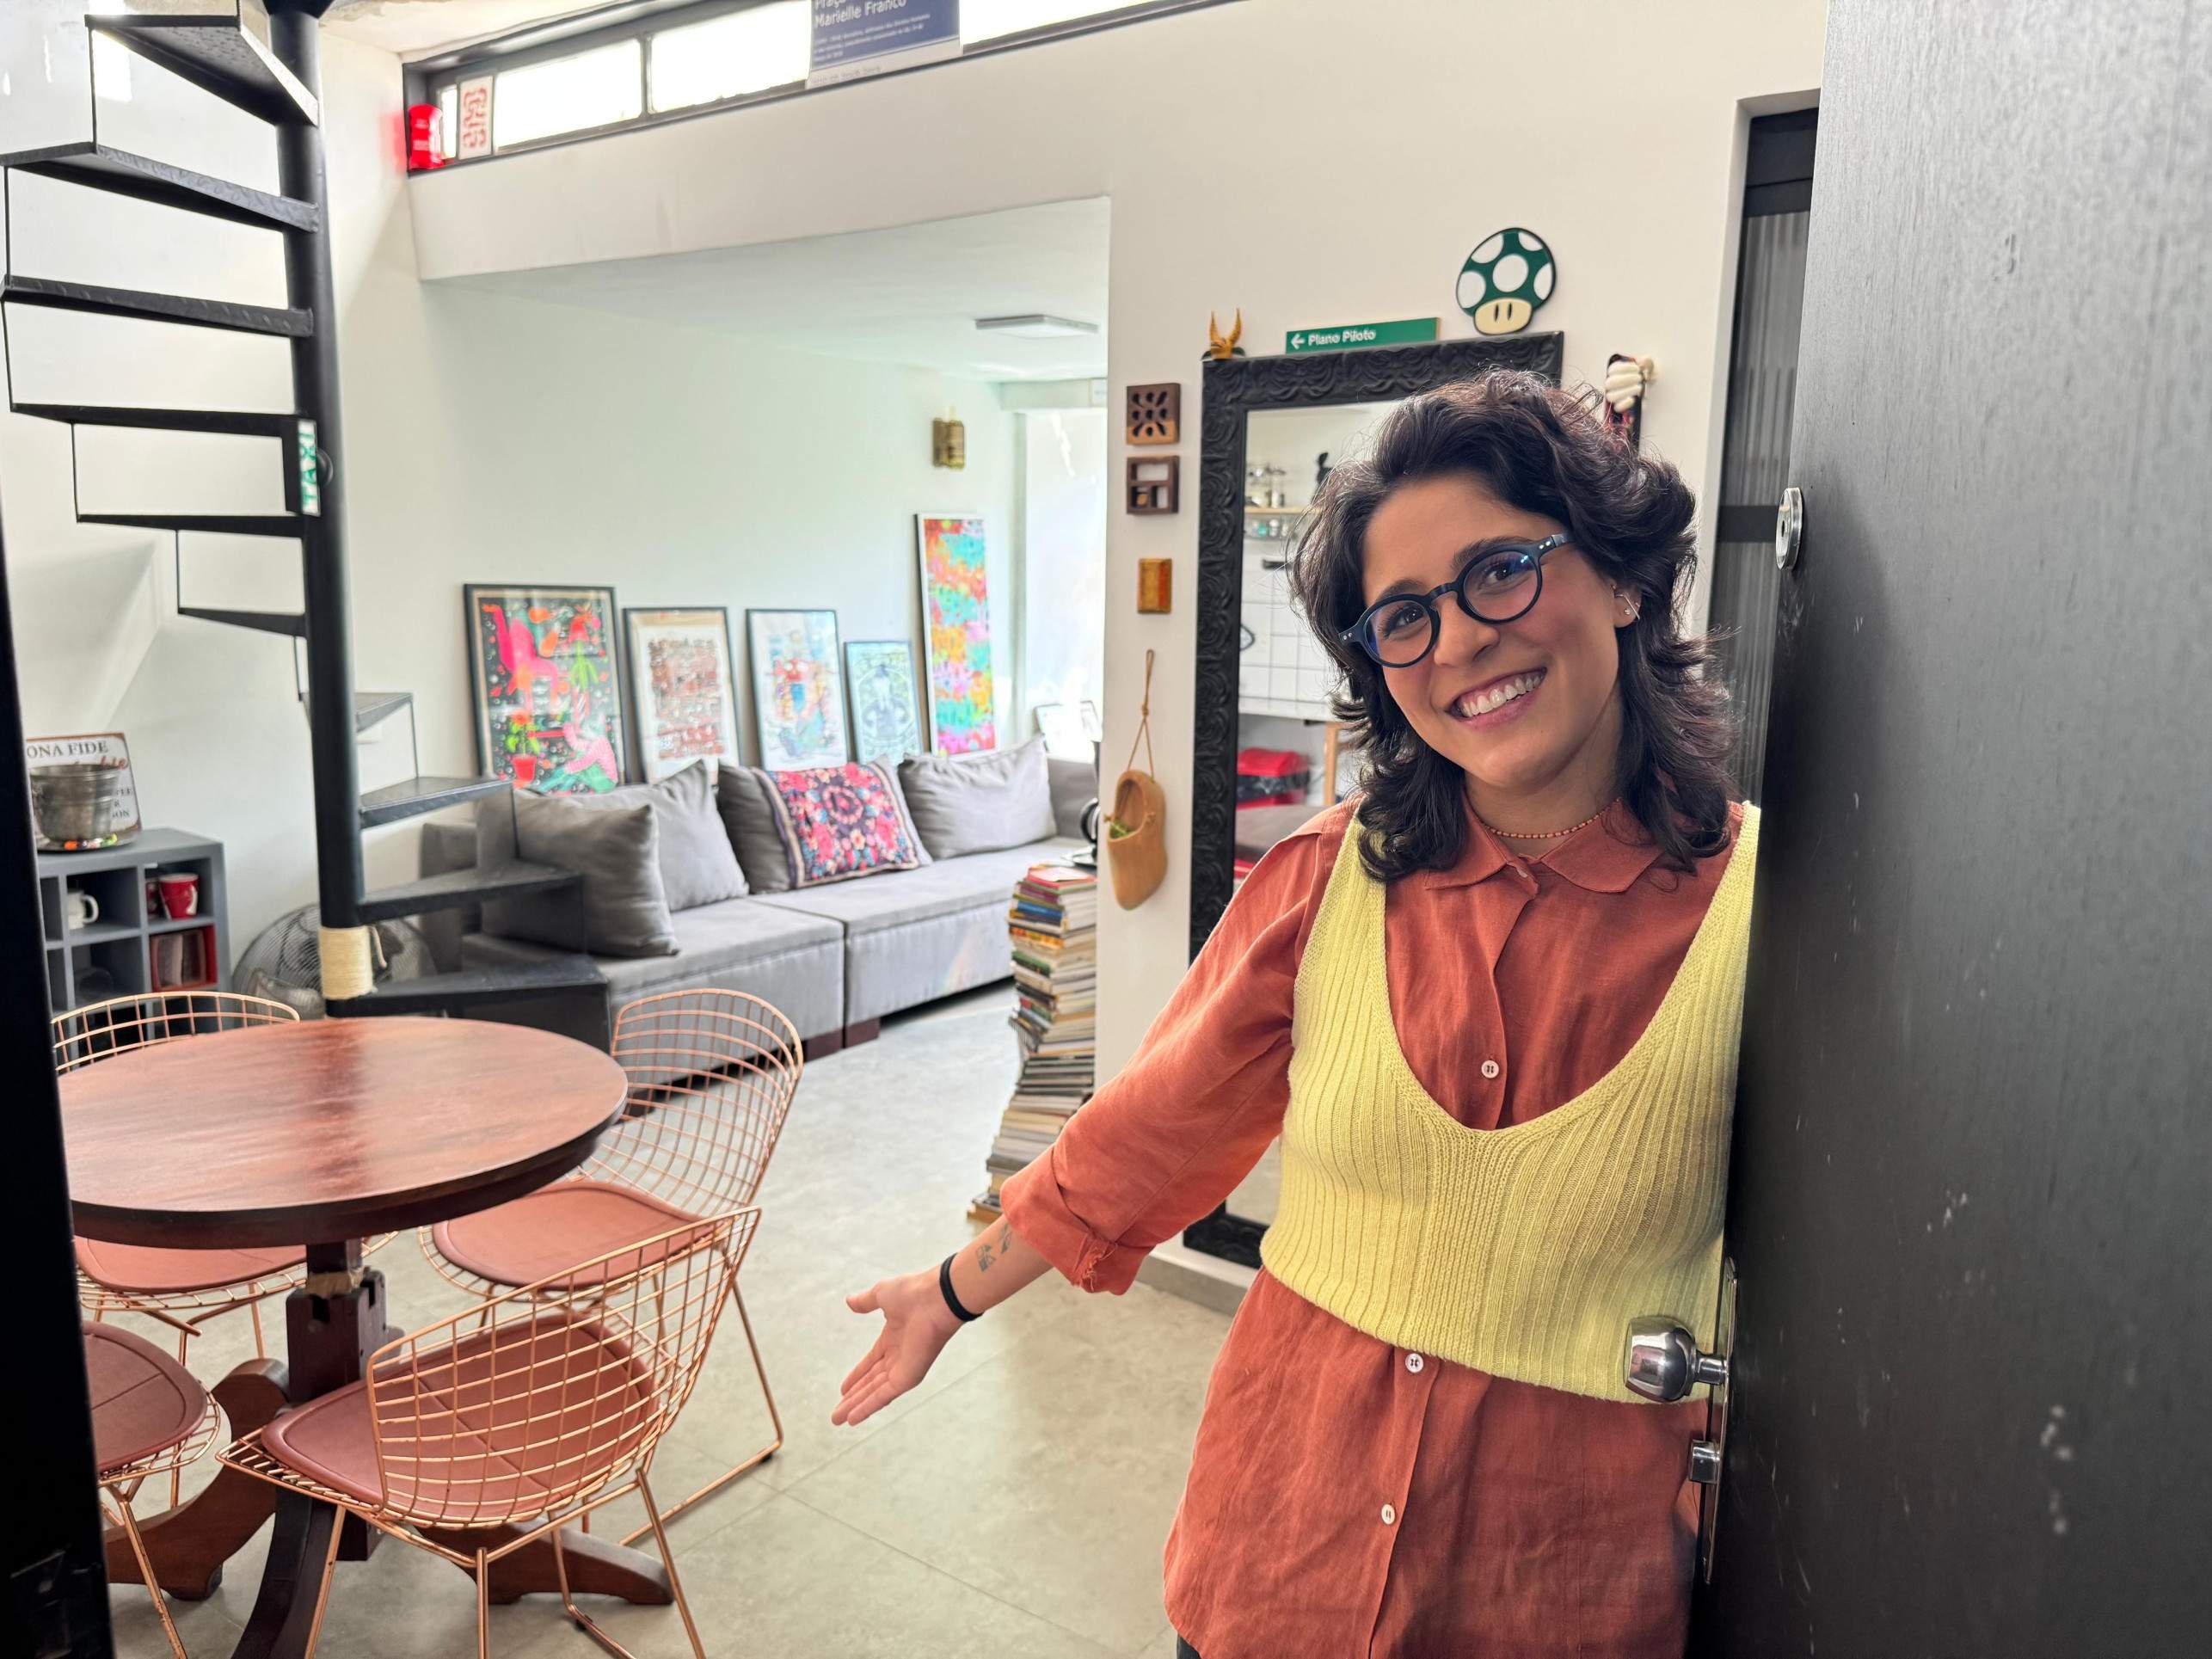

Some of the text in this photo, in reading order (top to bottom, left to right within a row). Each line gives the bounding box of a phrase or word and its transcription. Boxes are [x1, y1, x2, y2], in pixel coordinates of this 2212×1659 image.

[814, 0, 906, 28] Marielle Franco
[1308, 329, 1376, 346] Plano Piloto
[27, 740, 108, 759] ONA FIDE
